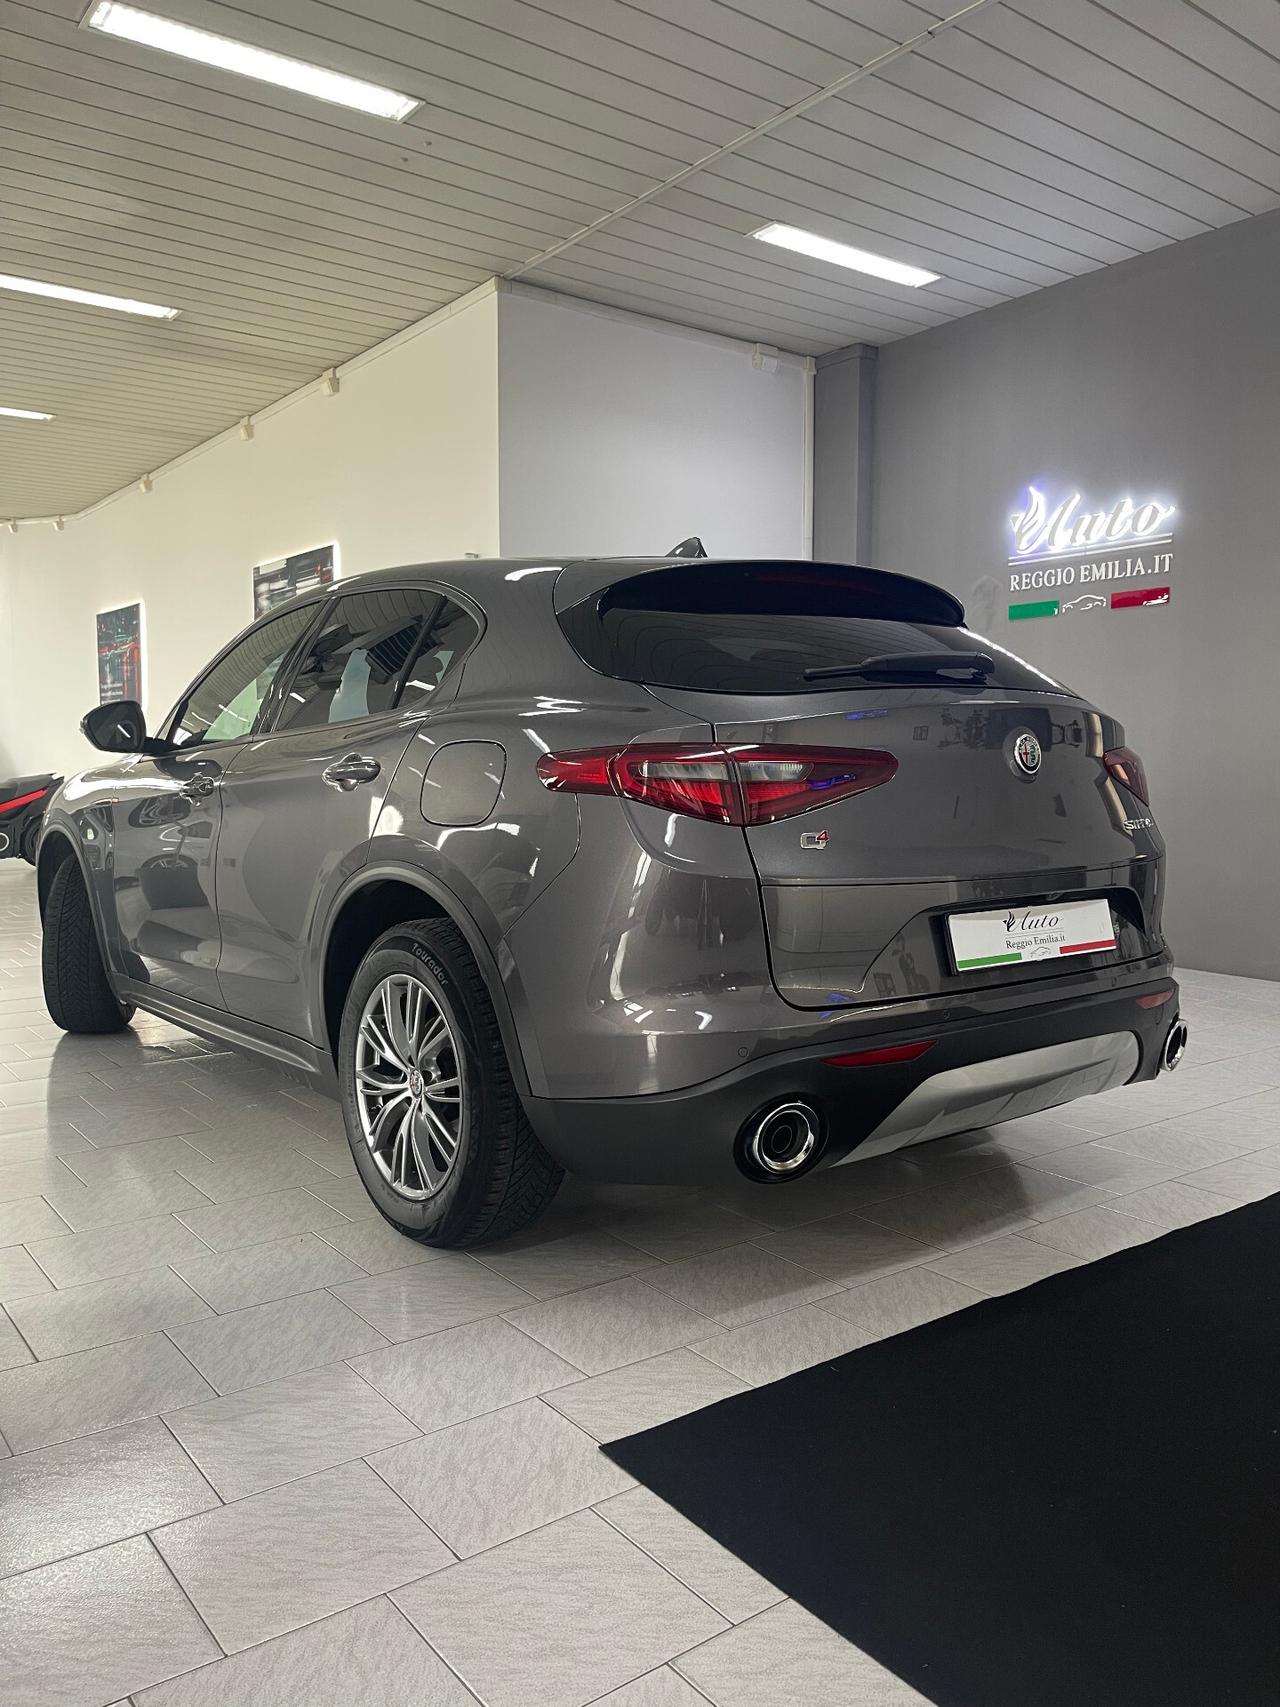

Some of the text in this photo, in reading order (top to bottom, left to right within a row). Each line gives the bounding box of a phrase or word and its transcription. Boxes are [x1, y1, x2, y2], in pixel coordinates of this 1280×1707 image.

[1009, 553, 1174, 592] REGGIO EMILIA.IT
[798, 830, 829, 850] Q4
[1006, 935, 1066, 951] Reggio Emilia.it
[412, 942, 449, 985] Tourador
